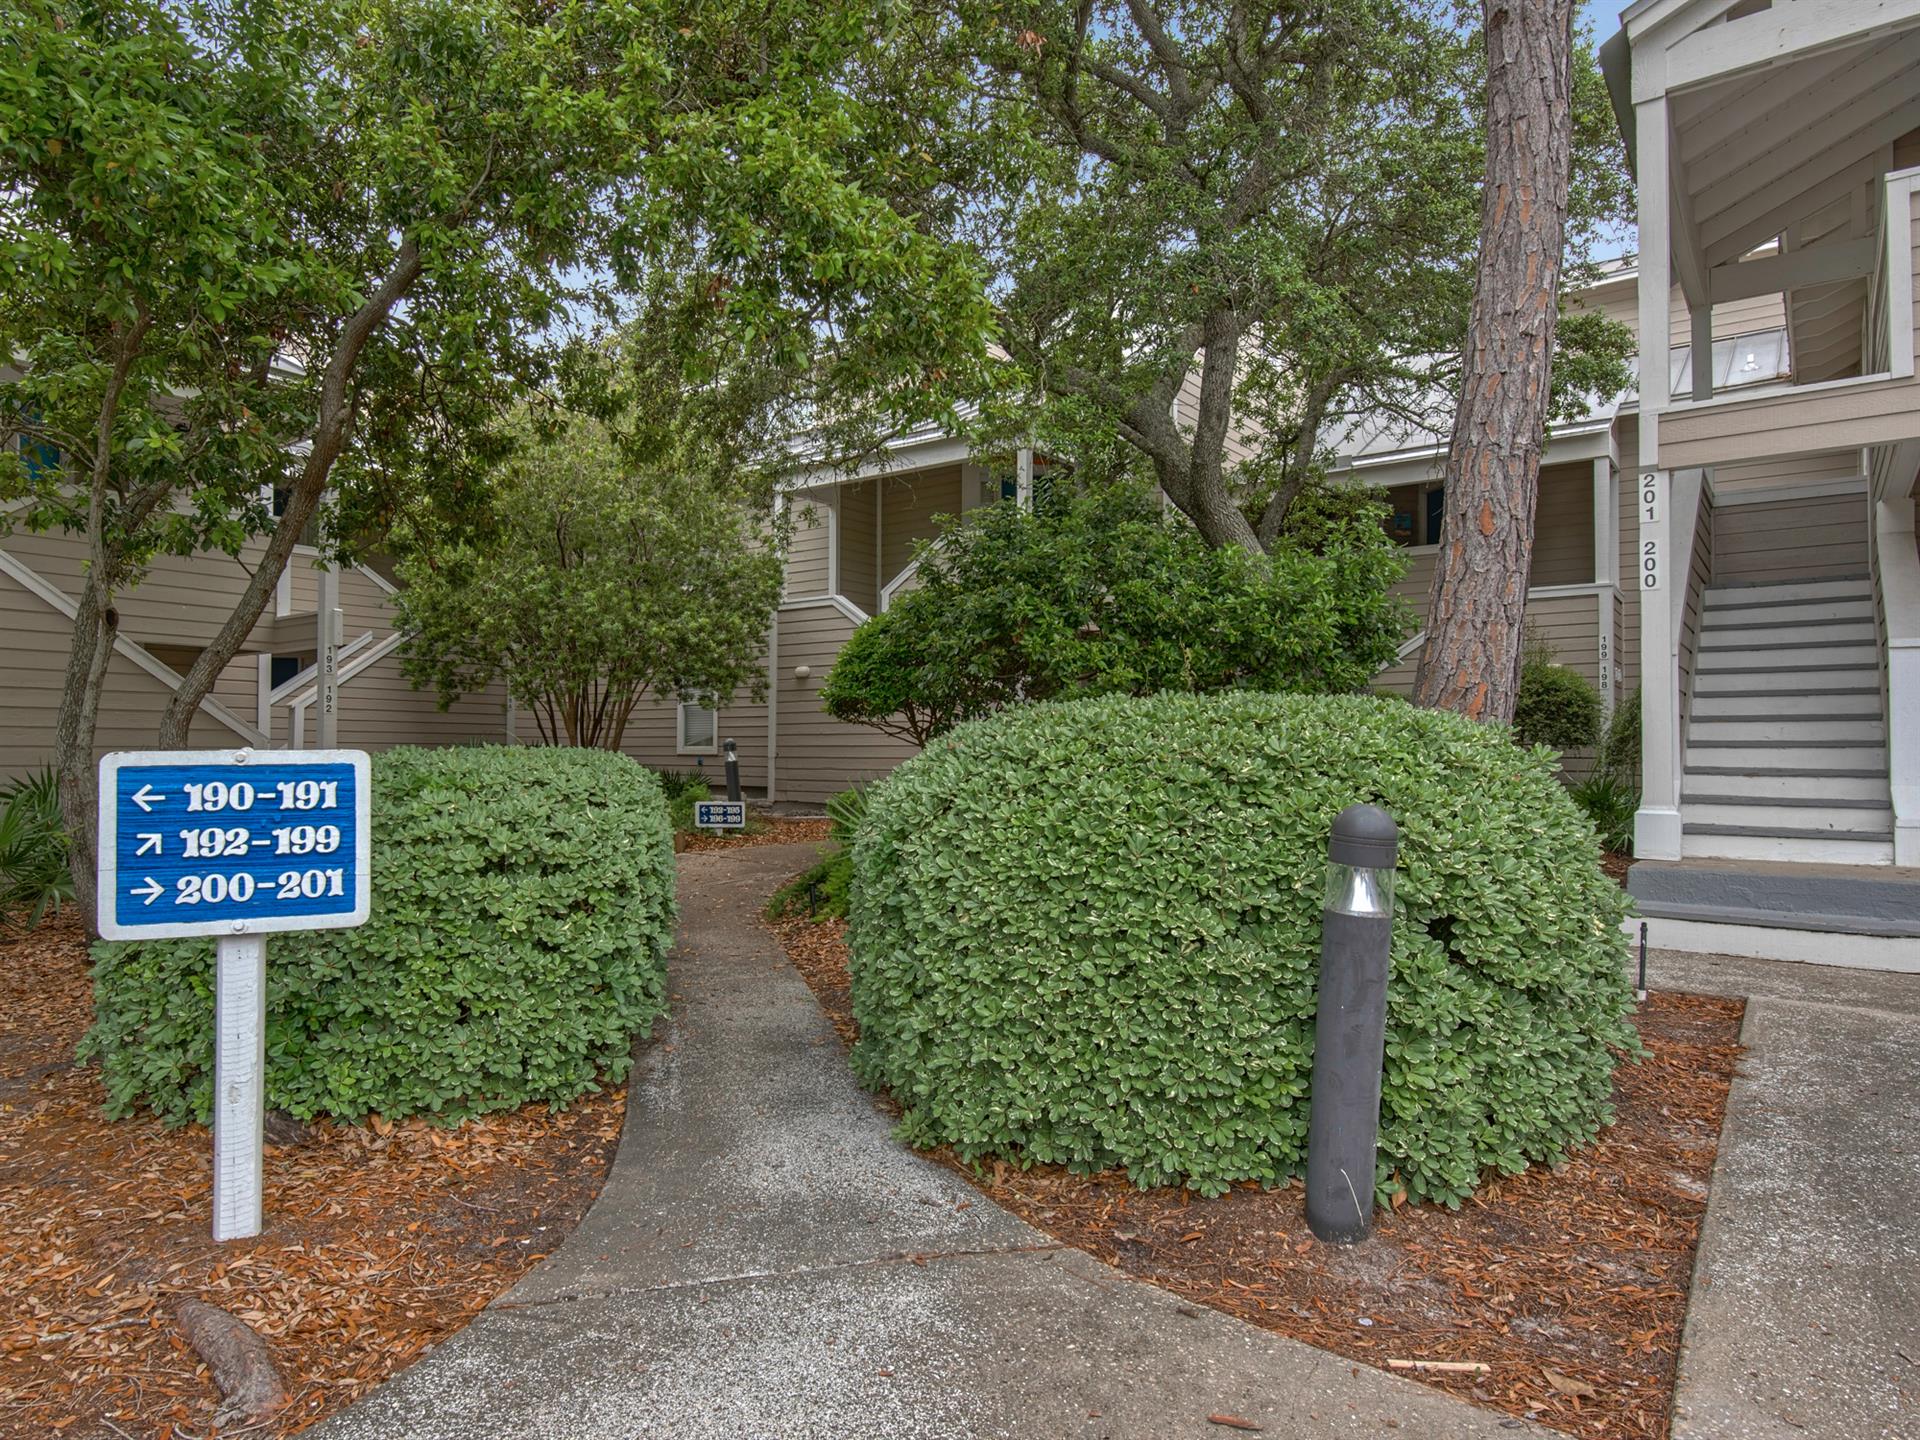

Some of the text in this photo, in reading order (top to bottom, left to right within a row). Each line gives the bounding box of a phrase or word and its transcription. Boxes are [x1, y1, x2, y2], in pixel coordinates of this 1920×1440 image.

[1643, 474, 1655, 520] 201
[1644, 541, 1656, 587] 200
[183, 780, 338, 812] 190-191
[179, 825, 341, 858] 192-199
[174, 868, 344, 904] 200-201
